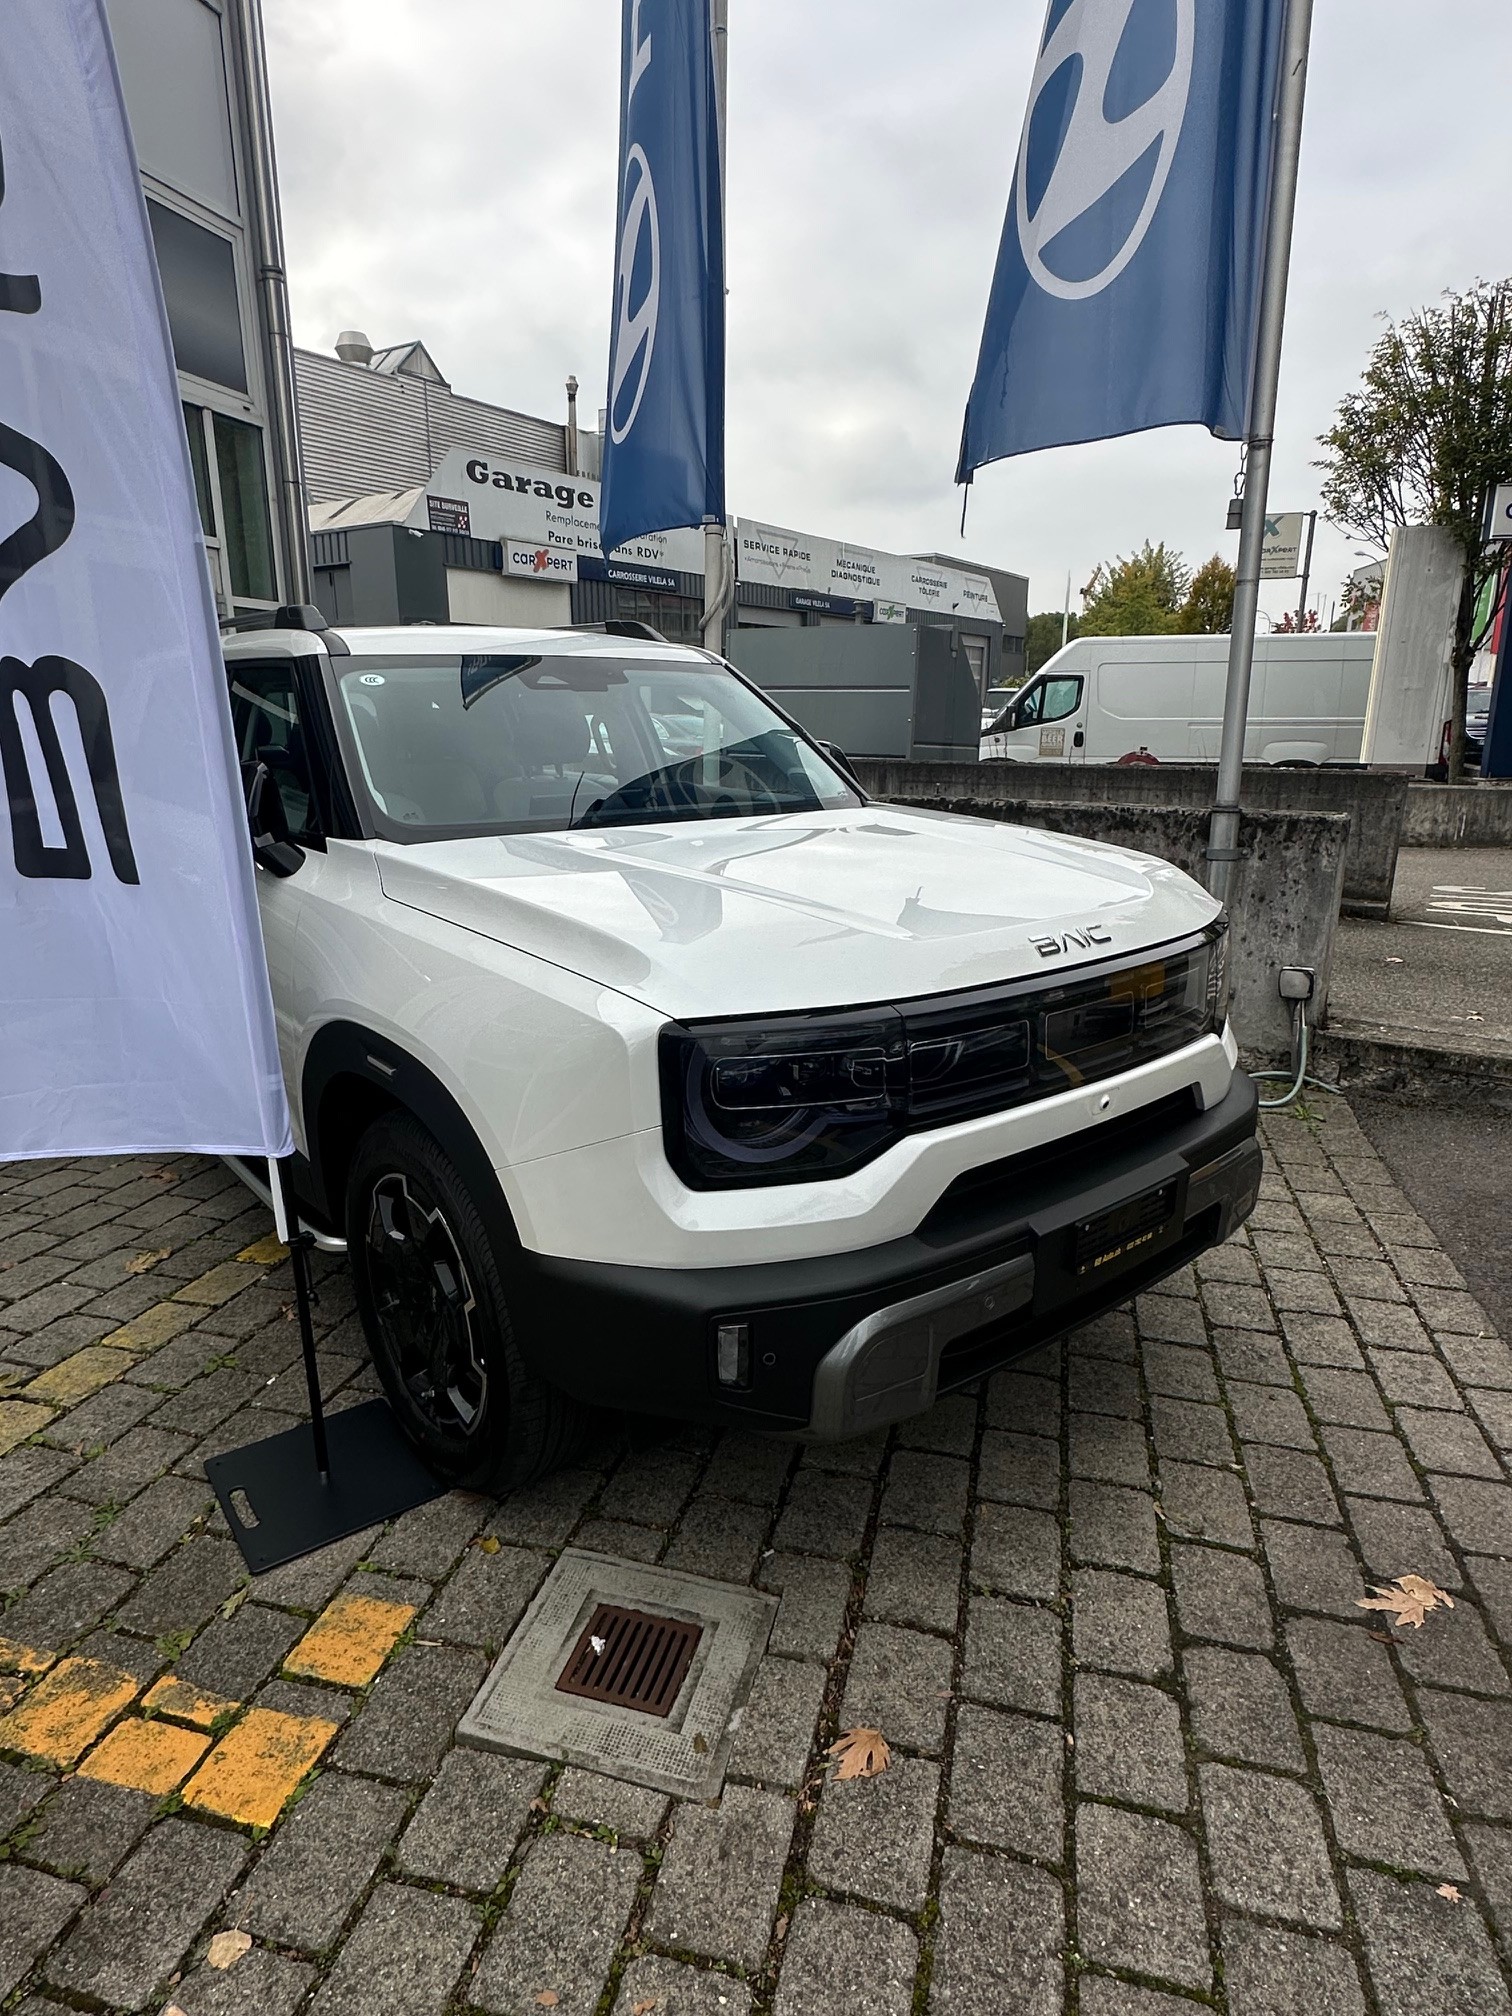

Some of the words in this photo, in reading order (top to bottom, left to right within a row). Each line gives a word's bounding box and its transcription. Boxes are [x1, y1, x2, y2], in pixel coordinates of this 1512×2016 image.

[466, 459, 595, 509] Garage
[548, 530, 573, 545] Pare
[743, 539, 780, 555] SERVICE
[783, 547, 811, 561] RAPIDE
[607, 569, 648, 583] CARROSSERIE
[667, 577, 676, 587] SA
[831, 569, 880, 587] DIAGNOSTIQUE
[911, 574, 948, 589] CARROSSERIE
[1041, 734, 1063, 744] BEER
[1028, 924, 1112, 958] BAIC
